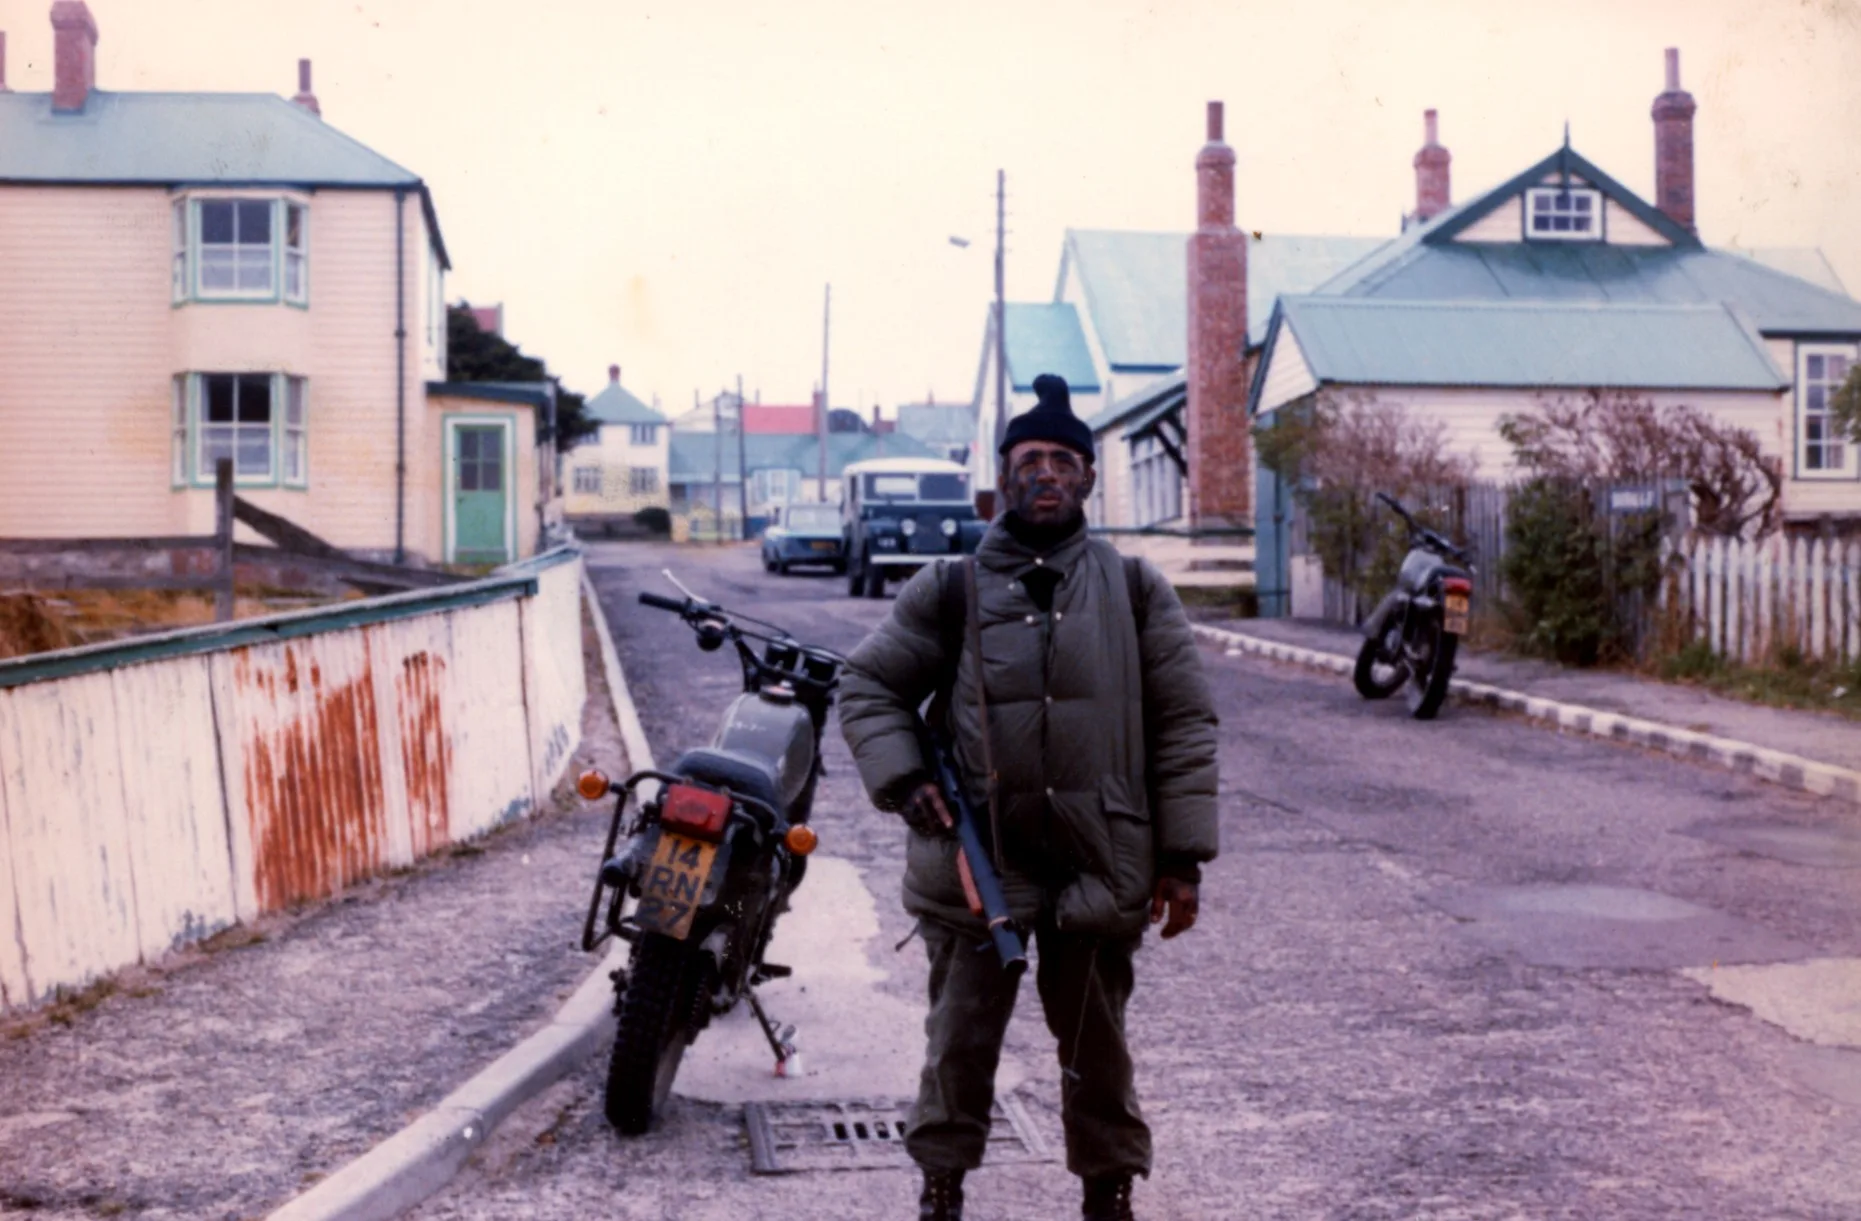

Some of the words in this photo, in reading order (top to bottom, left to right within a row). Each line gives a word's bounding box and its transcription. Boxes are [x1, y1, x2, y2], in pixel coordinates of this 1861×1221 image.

[667, 839, 702, 870] 14
[647, 865, 701, 901] RN
[636, 896, 690, 929] 27
